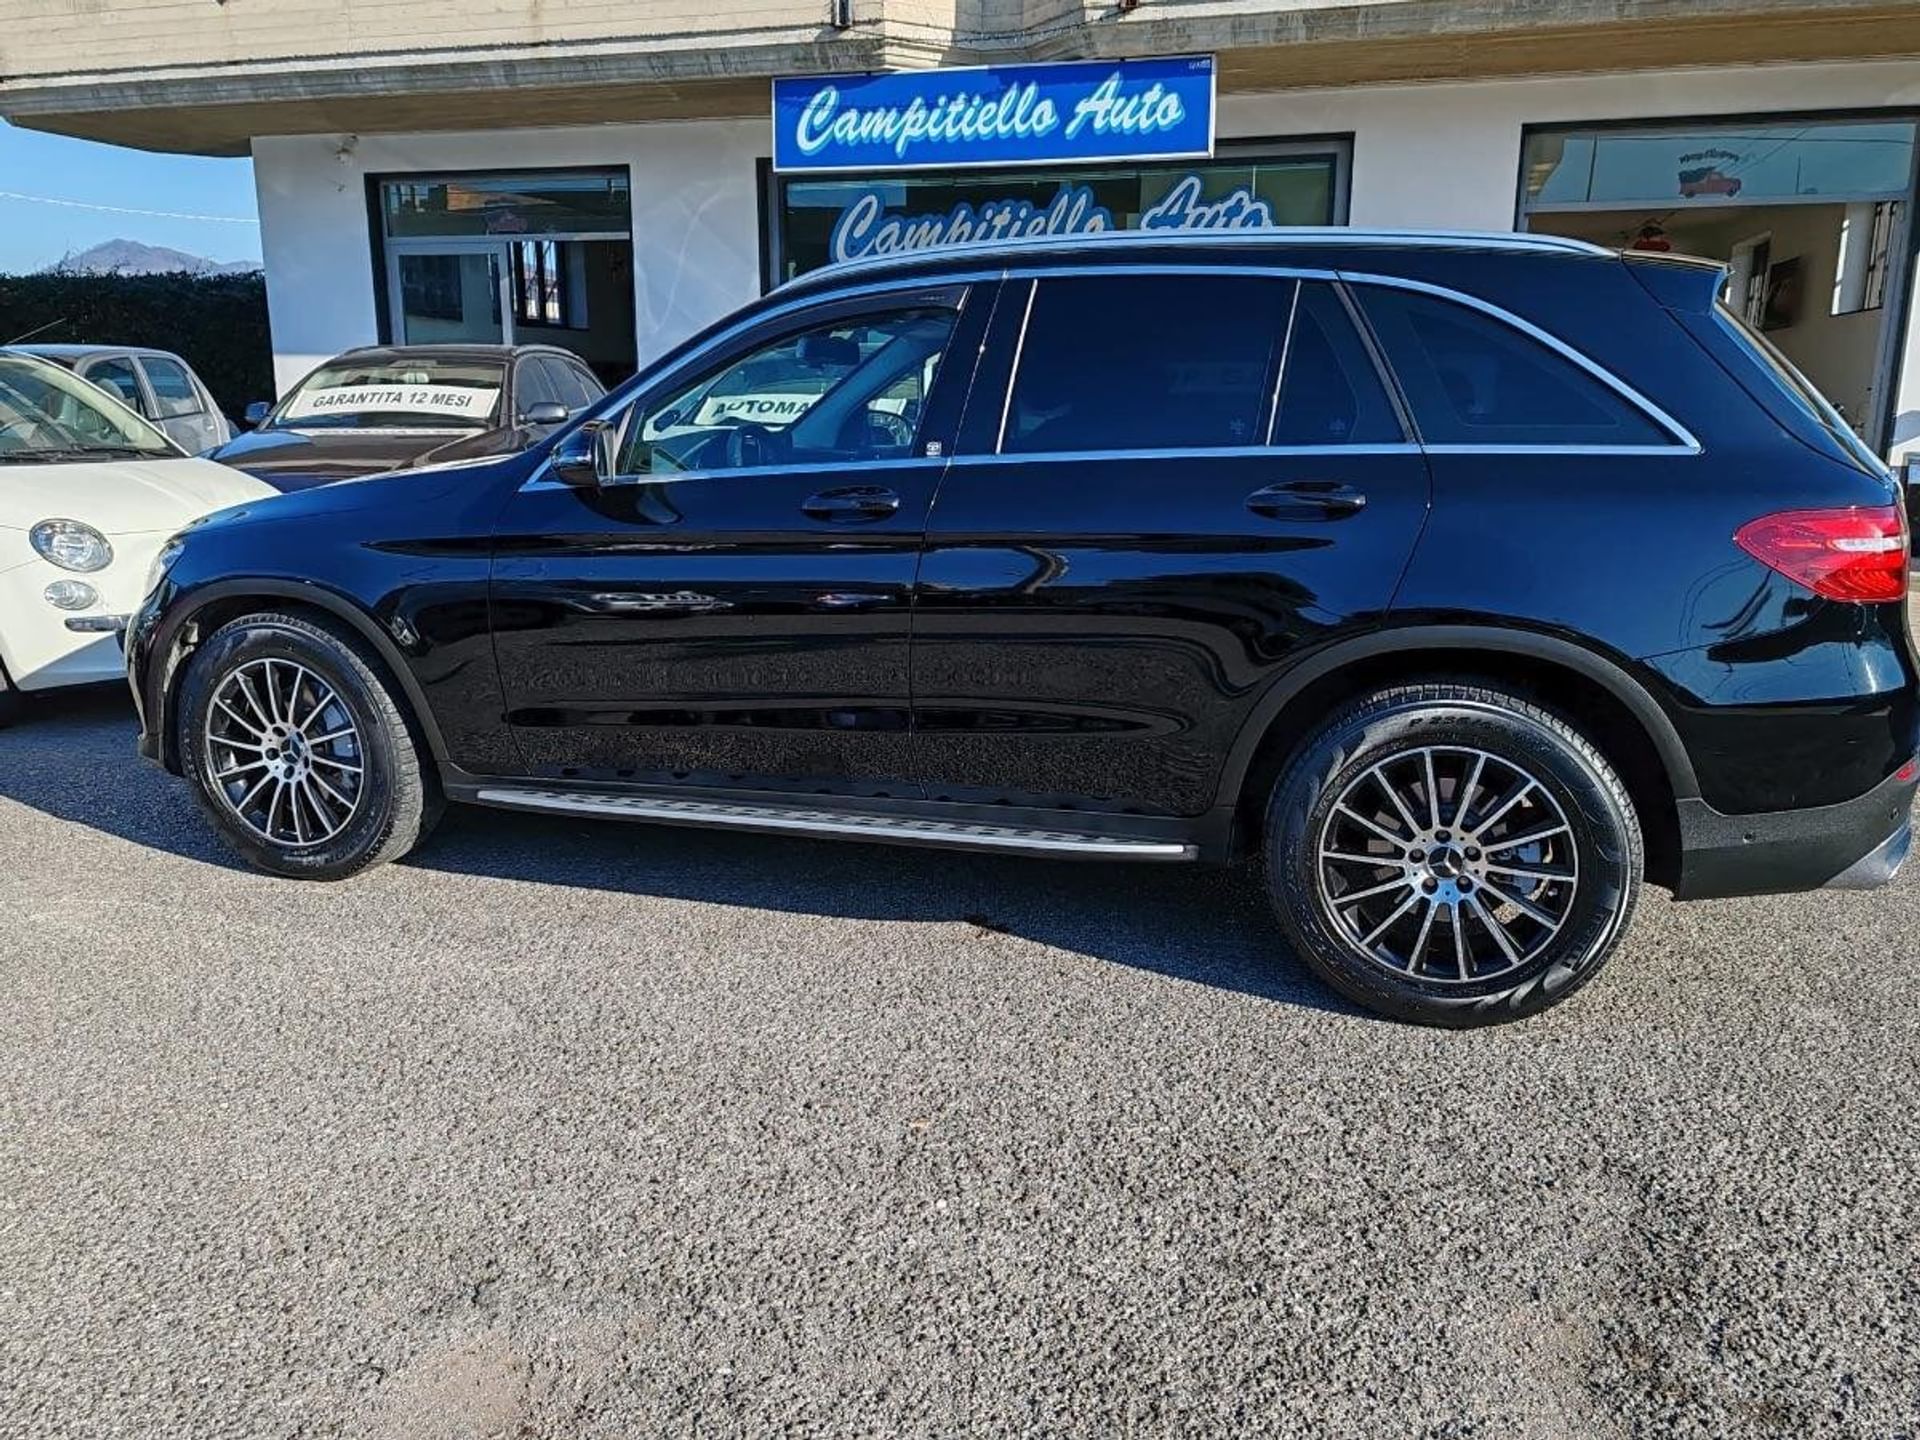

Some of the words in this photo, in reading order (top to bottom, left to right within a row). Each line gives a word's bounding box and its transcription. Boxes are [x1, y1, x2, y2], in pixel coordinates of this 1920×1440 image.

[797, 82, 1057, 158] Campitiello
[1065, 70, 1184, 140] Auto
[313, 391, 402, 408] GARANTITA
[409, 392, 428, 404] 12
[430, 393, 472, 407] MESI
